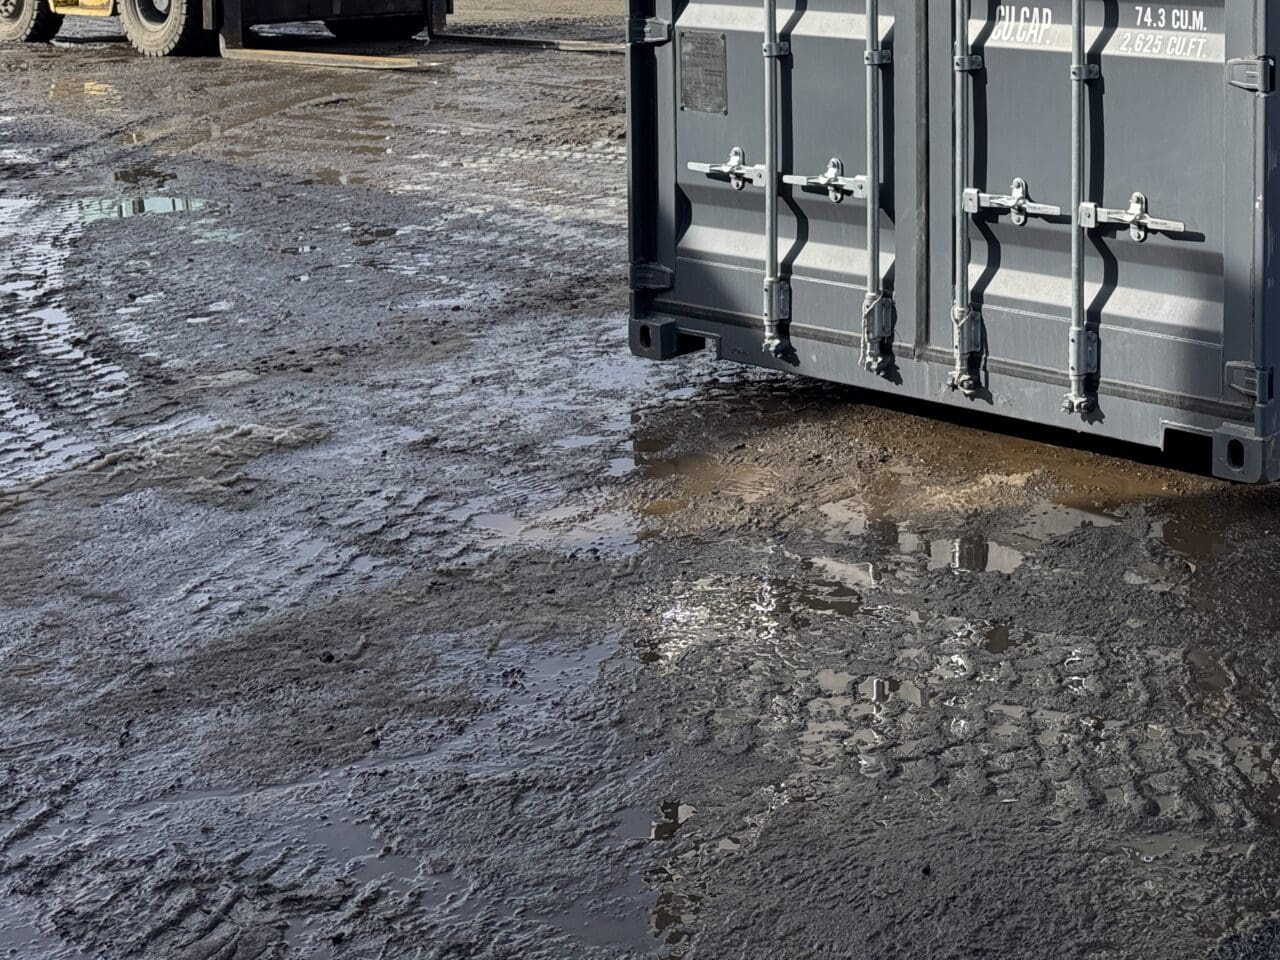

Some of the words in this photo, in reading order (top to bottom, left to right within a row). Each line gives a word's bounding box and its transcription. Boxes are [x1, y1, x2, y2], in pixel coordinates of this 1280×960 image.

[991, 5, 1052, 44] CU.CAP.
[1135, 6, 1166, 28] 74.3
[1171, 8, 1207, 32] CU.M.
[1120, 32, 1163, 54] 2,625
[1166, 36, 1207, 58] CU.FT.
